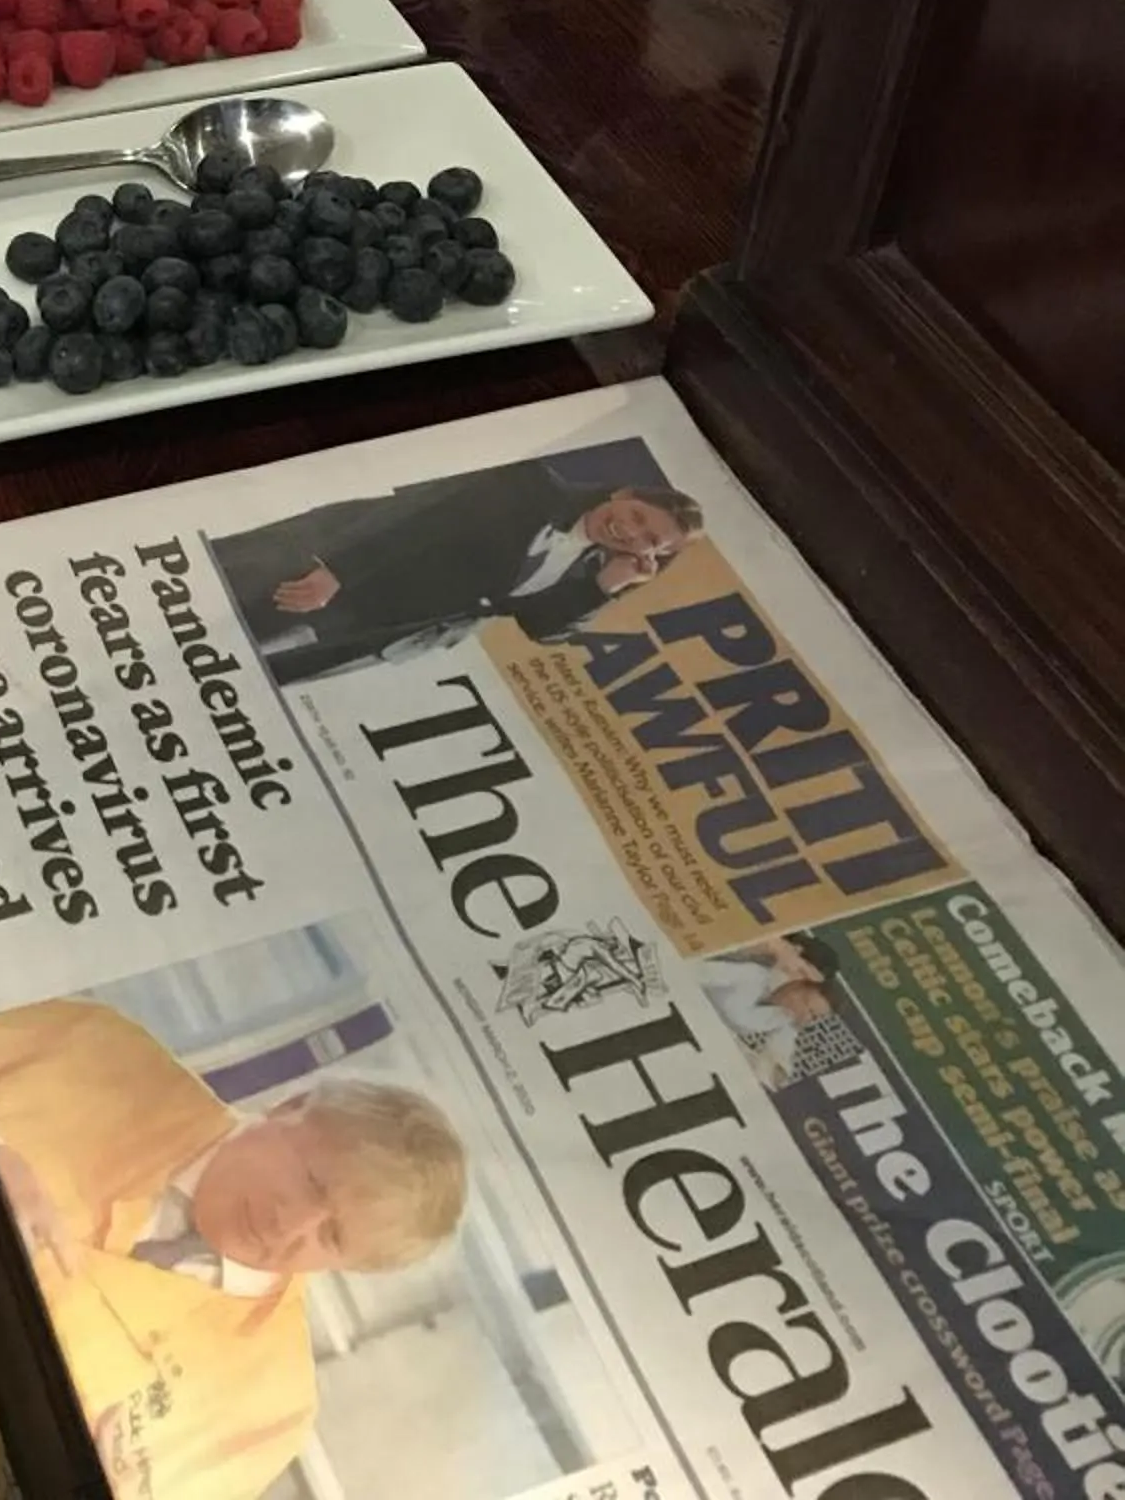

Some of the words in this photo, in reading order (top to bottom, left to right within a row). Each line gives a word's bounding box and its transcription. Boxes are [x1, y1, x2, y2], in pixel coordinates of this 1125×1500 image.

[5, 570, 178, 917] coronavirus
[68, 551, 157, 691] fears
[130, 699, 189, 763] as
[161, 768, 265, 907] first
[134, 537, 293, 810] Pandemic
[358, 674, 560, 939] The
[563, 628, 825, 927] AWFUL
[645, 591, 949, 897] PRITI
[621, 754, 654, 793] Why
[647, 795, 669, 821] we
[664, 823, 698, 867] must
[621, 838, 659, 890] Taylor
[648, 842, 669, 860] of
[660, 864, 687, 892] our
[818, 1049, 931, 1201] The
[846, 926, 900, 989] into
[892, 995, 947, 1059] cup
[938, 1065, 1081, 1244] semi-final
[881, 918, 953, 1007] Celtic
[943, 1014, 1014, 1099] stars
[1001, 1105, 1097, 1211] power
[910, 907, 1019, 1049] Lennon's
[1007, 1056, 1099, 1161] praise
[947, 895, 1112, 1106] Comeback
[803, 1116, 858, 1193] Giant
[844, 1194, 905, 1265] prize
[900, 1270, 1012, 1423] crossword
[984, 1180, 1054, 1261] SPORT
